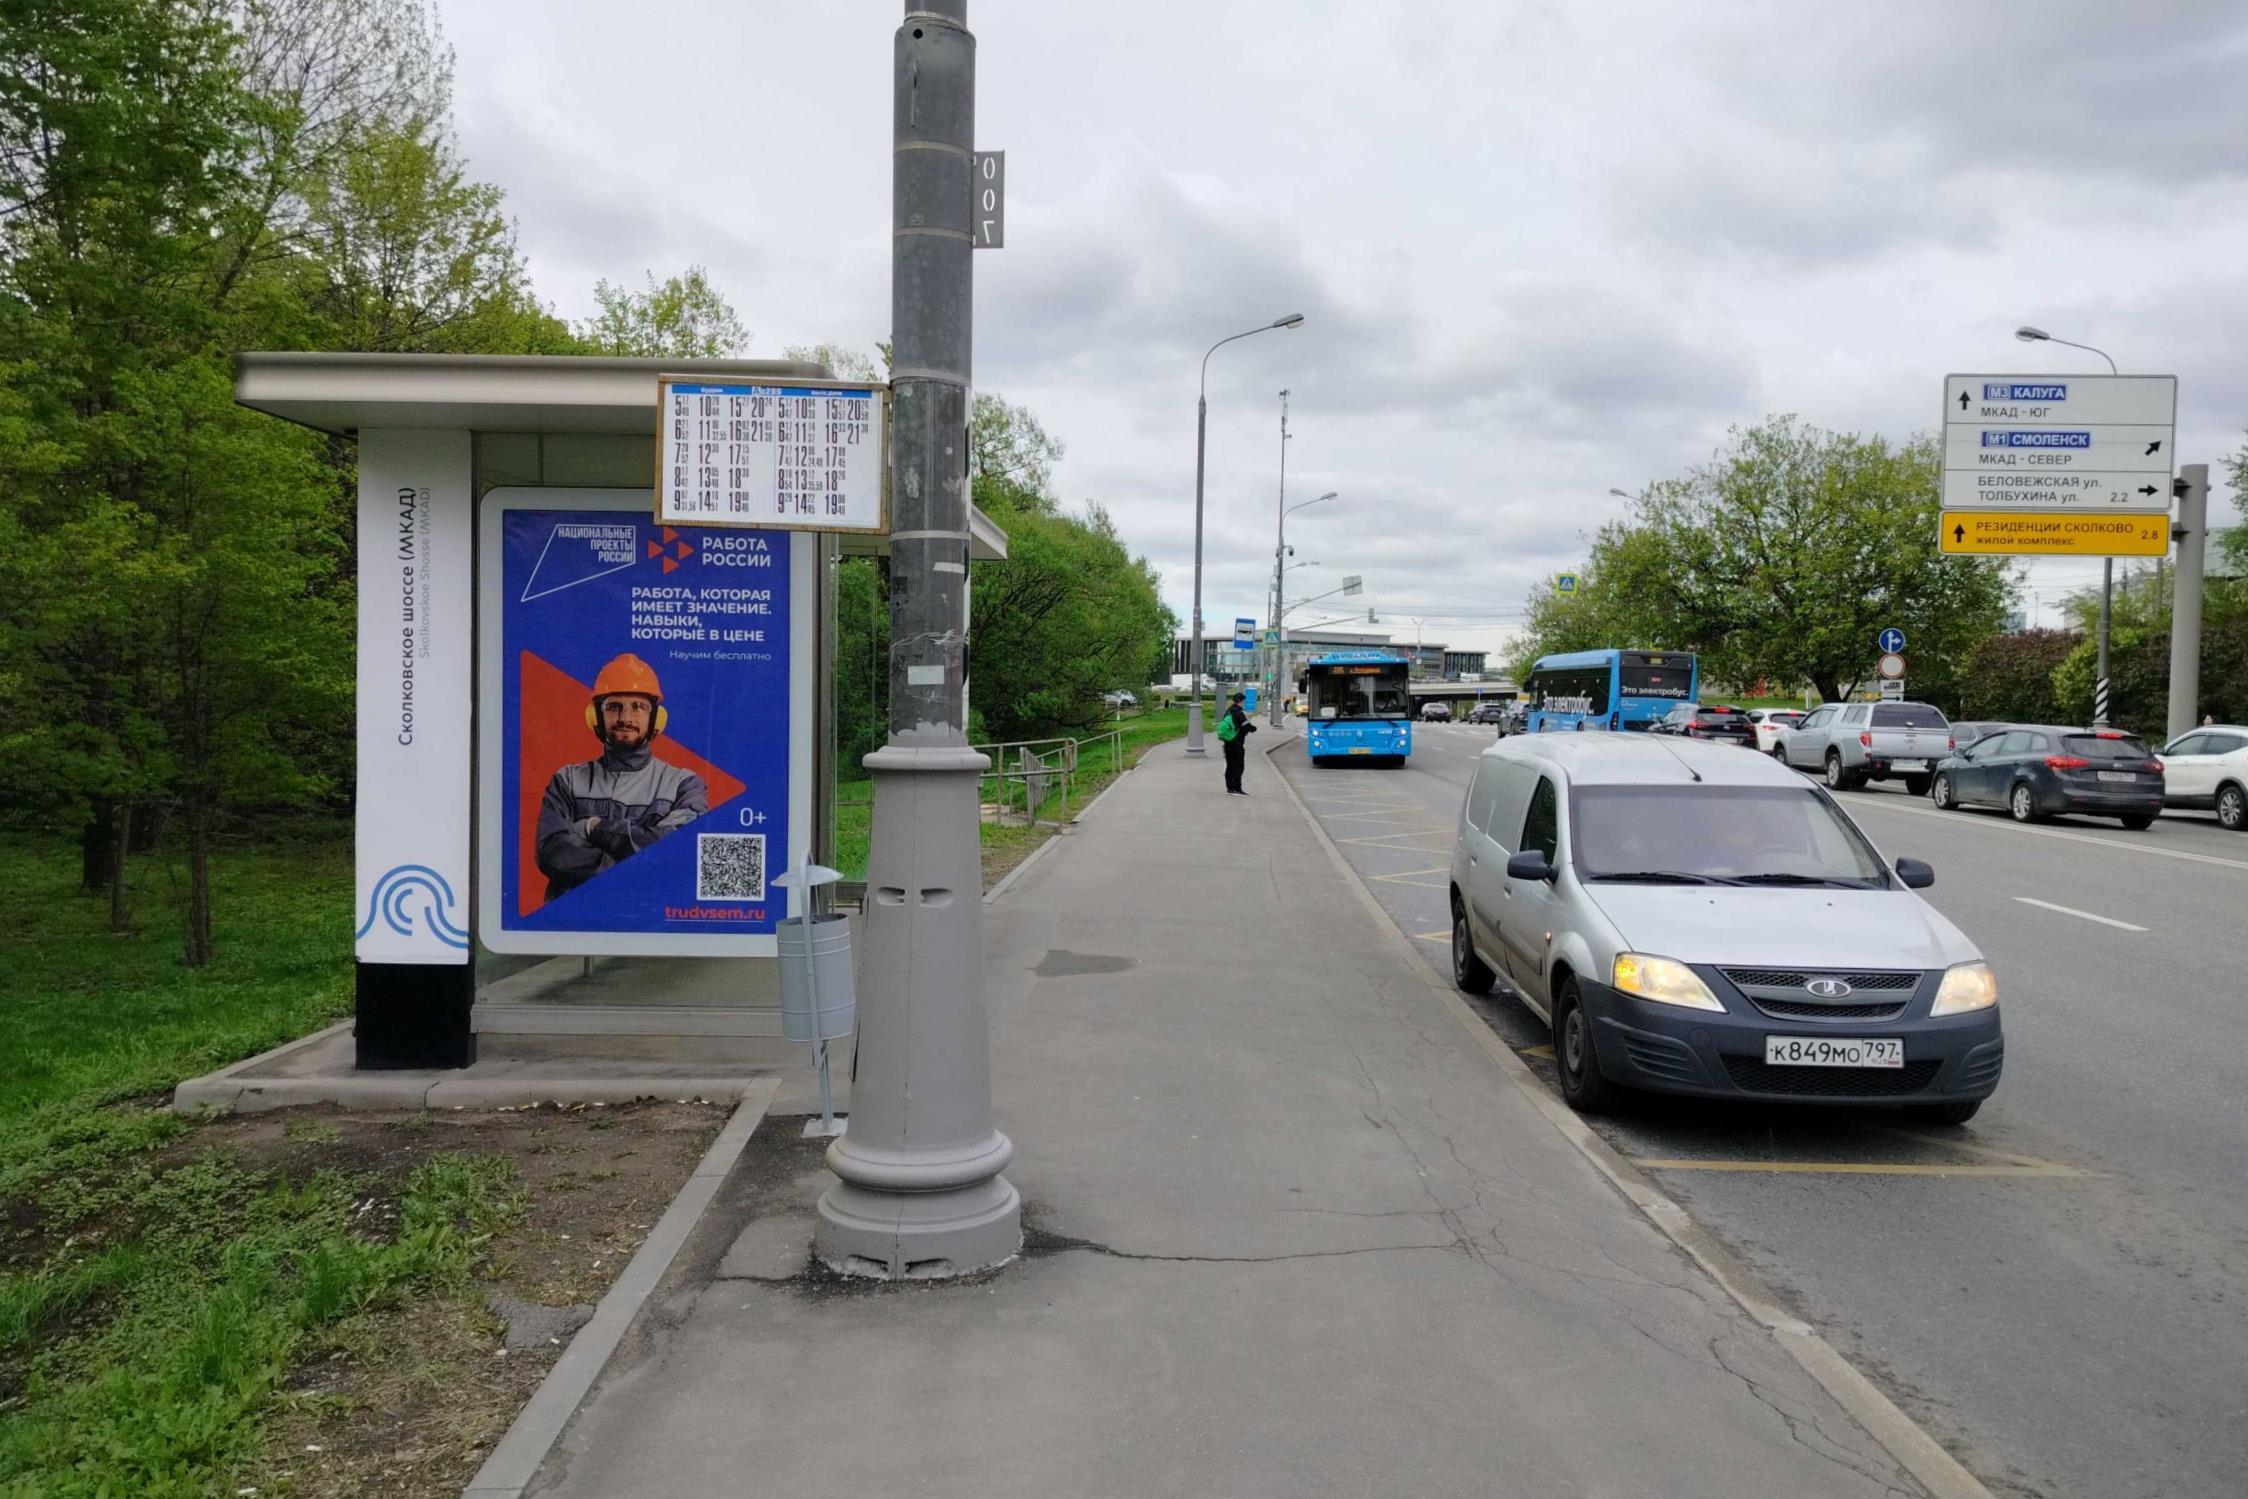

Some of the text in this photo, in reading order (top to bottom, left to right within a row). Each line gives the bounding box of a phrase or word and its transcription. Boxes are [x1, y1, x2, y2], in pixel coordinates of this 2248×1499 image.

[1990, 386, 2065, 398] М3 КАЛУГА
[676, 396, 682, 416] 5
[699, 396, 712, 416] 10
[729, 397, 742, 417] 15
[752, 397, 772, 418] 20 24
[779, 398, 784, 418] 5
[795, 398, 808, 418] 10
[826, 399, 838, 420] 15
[848, 400, 860, 420] 20
[1981, 407, 2018, 418] МКАД
[2030, 408, 2050, 418] ЮГ
[676, 419, 682, 440] 6
[699, 420, 710, 440] 11
[729, 420, 742, 441] 16
[752, 421, 762, 442] 21
[779, 422, 784, 442] 6
[795, 422, 806, 442] 11
[826, 422, 838, 444] 16
[848, 424, 859, 444] 21
[1988, 434, 2087, 446] М1 СМОЛЕНСК
[675, 443, 680, 463] 7
[698, 444, 711, 464] 12
[729, 444, 741, 464] 17
[778, 445, 784, 466] 7
[795, 446, 807, 466] 12
[825, 447, 837, 467] 17
[1980, 454, 2016, 466] МКАД
[2028, 454, 2072, 465] СЕВЕР
[675, 466, 680, 487] 8
[698, 467, 710, 488] 13
[728, 468, 741, 488] 18
[778, 469, 784, 490] 8
[795, 470, 807, 490] 13
[825, 471, 837, 491] 18
[1978, 476, 2102, 490] БЕЛОВЕЖСКАЯ ул.
[674, 490, 680, 510] 9
[698, 490, 710, 511] 14
[728, 491, 740, 512] 19
[778, 492, 784, 513] 9
[794, 494, 806, 514] 14
[825, 494, 837, 514] 19
[1978, 490, 2128, 504] ТОЛБУХИНА ул. 2.2
[558, 528, 632, 540] НАЦИОНАЛЬНЫЕ
[1976, 522, 2158, 540] РЕЗИДЕНЦИИ СКОЛКОВО 2.8
[1976, 535, 2074, 546] жилой комплекс
[591, 540, 632, 550] ПРОЕКТЫ
[702, 537, 767, 551] РАБОТА
[598, 551, 632, 562] РОССИИ
[702, 554, 771, 567] РОССИИ
[419, 488, 432, 658] Skolkovskoe Shosse (MKAD)
[632, 587, 770, 600] РАБОТА, КОТОРАЯ
[398, 488, 417, 746] Сколковское шоссе (МКАД)
[632, 602, 772, 614] ИМЕЕТ ЗНАЧЕНИЕ.
[632, 616, 702, 628] НАВЫКИ,
[632, 629, 764, 644] КОТОРЫЕ В ЦЕНЕ
[670, 650, 772, 661] Научим бесплатно
[1622, 686, 1688, 698] Это электробус.
[740, 808, 766, 826] 0+
[664, 906, 765, 919] trudvsem.ru
[1864, 1042, 1896, 1058] 797
